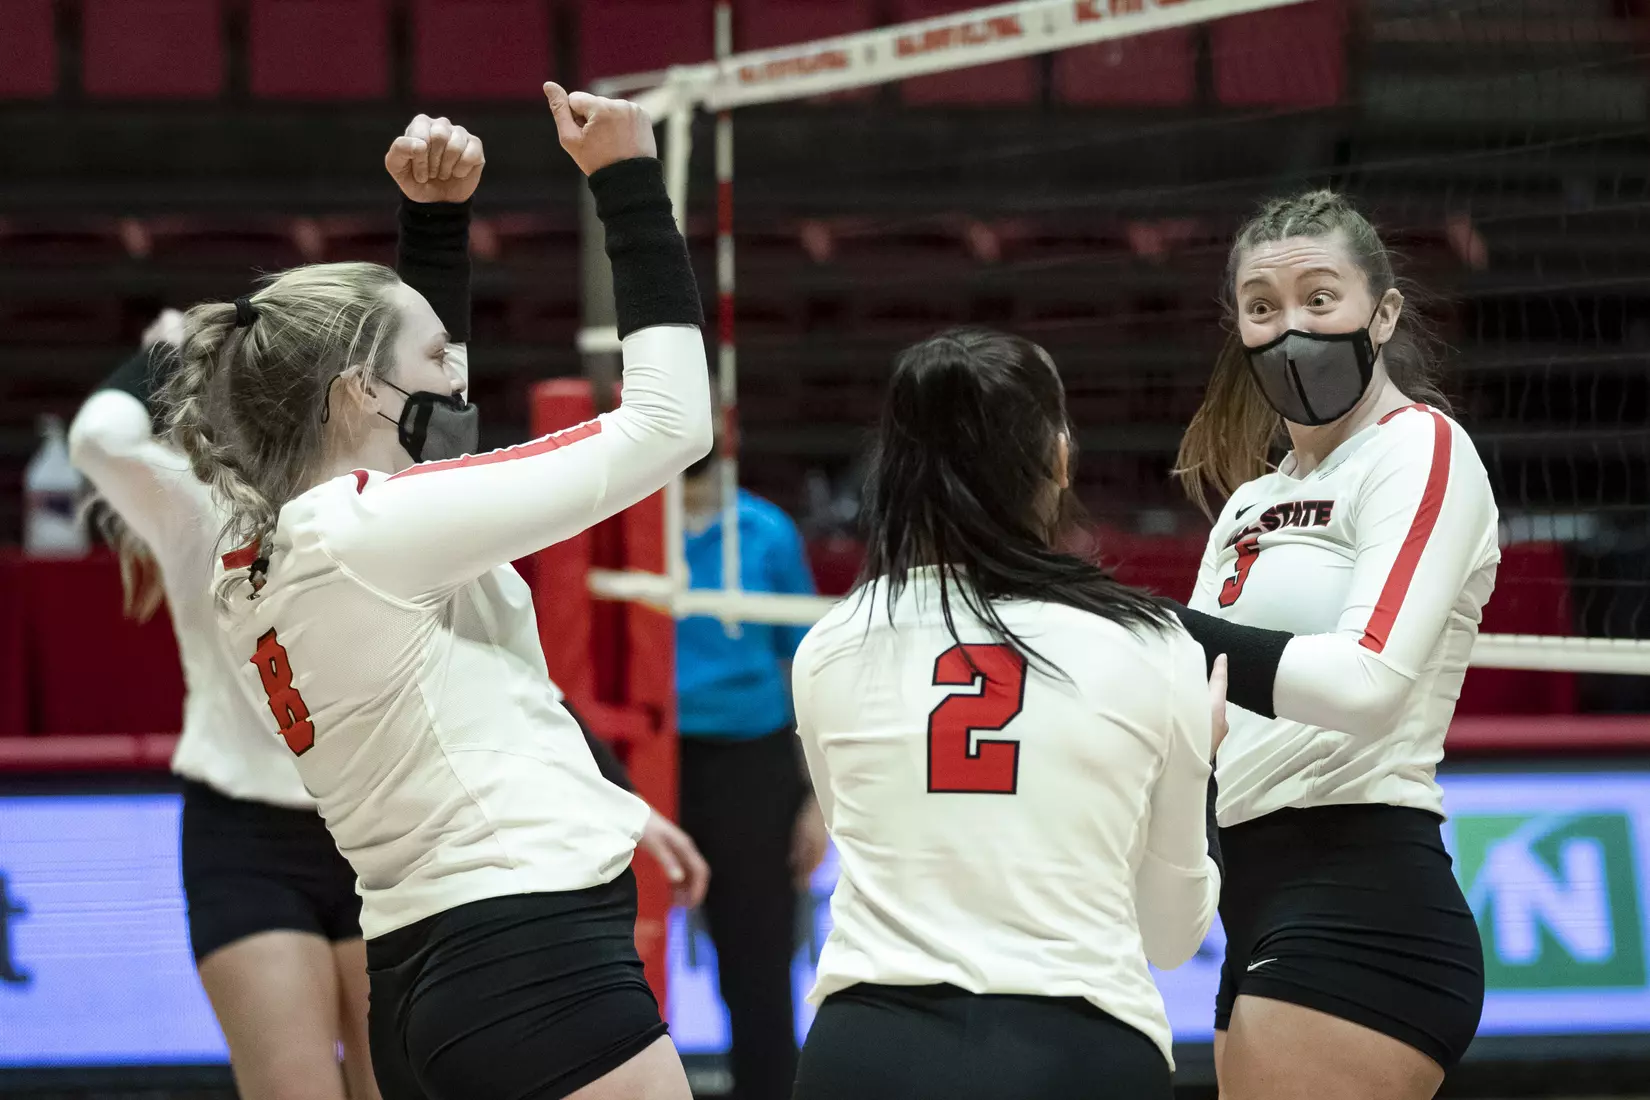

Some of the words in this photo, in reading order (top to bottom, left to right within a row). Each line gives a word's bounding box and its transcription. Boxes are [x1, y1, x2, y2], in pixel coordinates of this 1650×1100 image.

[1260, 500, 1335, 532] STATE
[250, 627, 315, 757] 8
[927, 642, 1027, 794] 2
